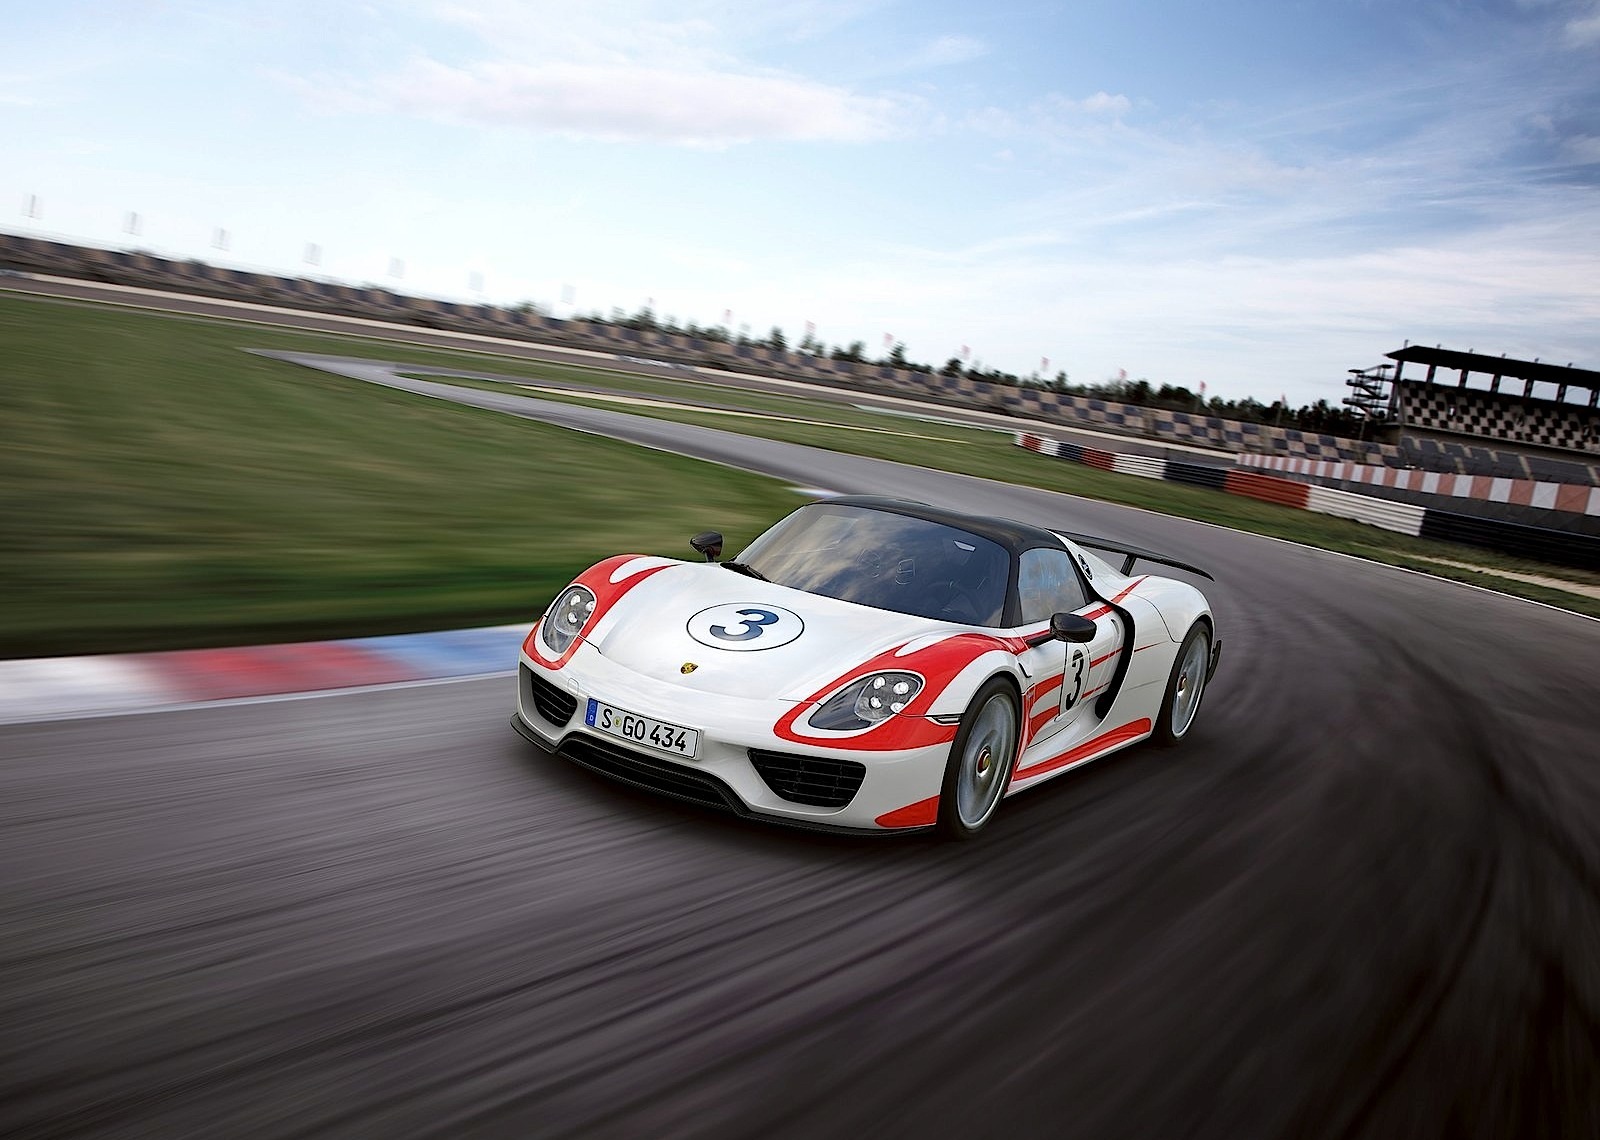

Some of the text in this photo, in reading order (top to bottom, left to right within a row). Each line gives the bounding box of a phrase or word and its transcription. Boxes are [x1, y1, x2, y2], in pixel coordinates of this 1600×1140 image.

[709, 608, 779, 641] 3
[1065, 649, 1084, 711] 3
[601, 708, 686, 751] S GO 434
